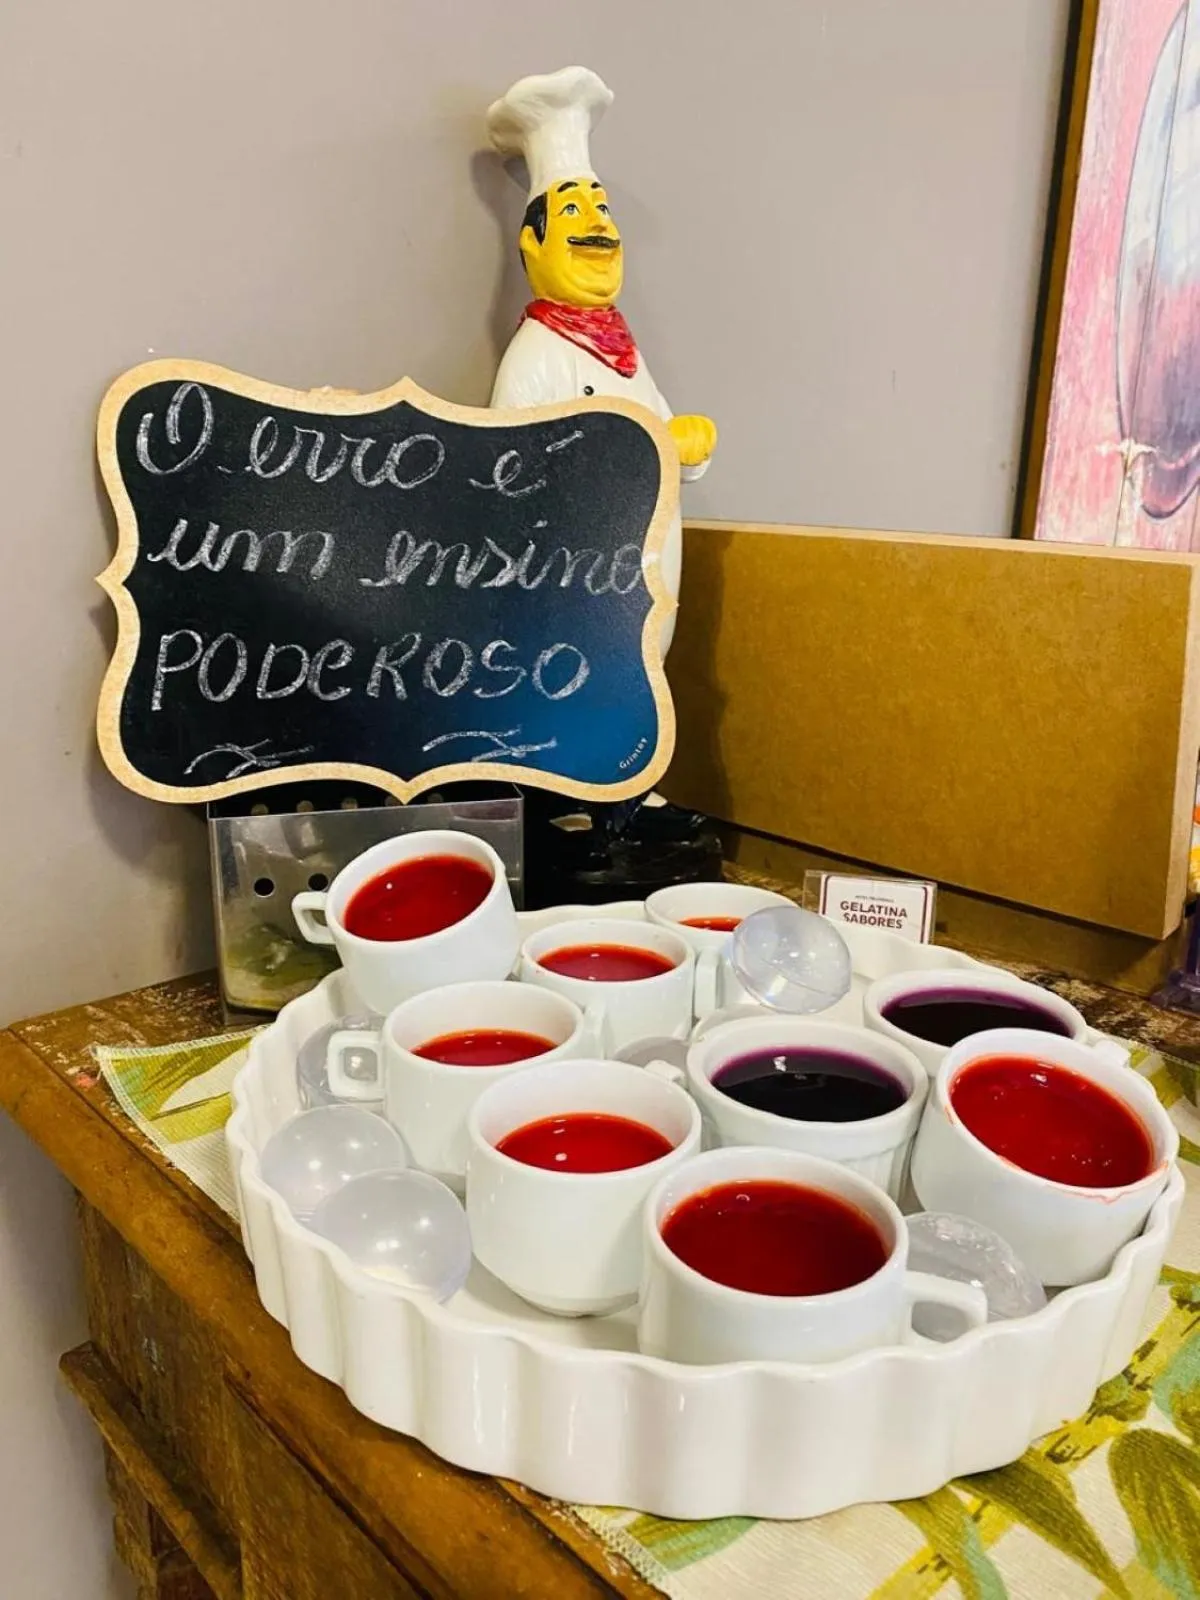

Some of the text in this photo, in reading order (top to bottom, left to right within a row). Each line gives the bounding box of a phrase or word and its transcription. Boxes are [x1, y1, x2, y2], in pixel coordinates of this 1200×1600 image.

[137, 383, 584, 497] O erro é
[147, 518, 645, 596] um ensino
[840, 900, 907, 918] GELATINA
[843, 912, 903, 929] SABORES
